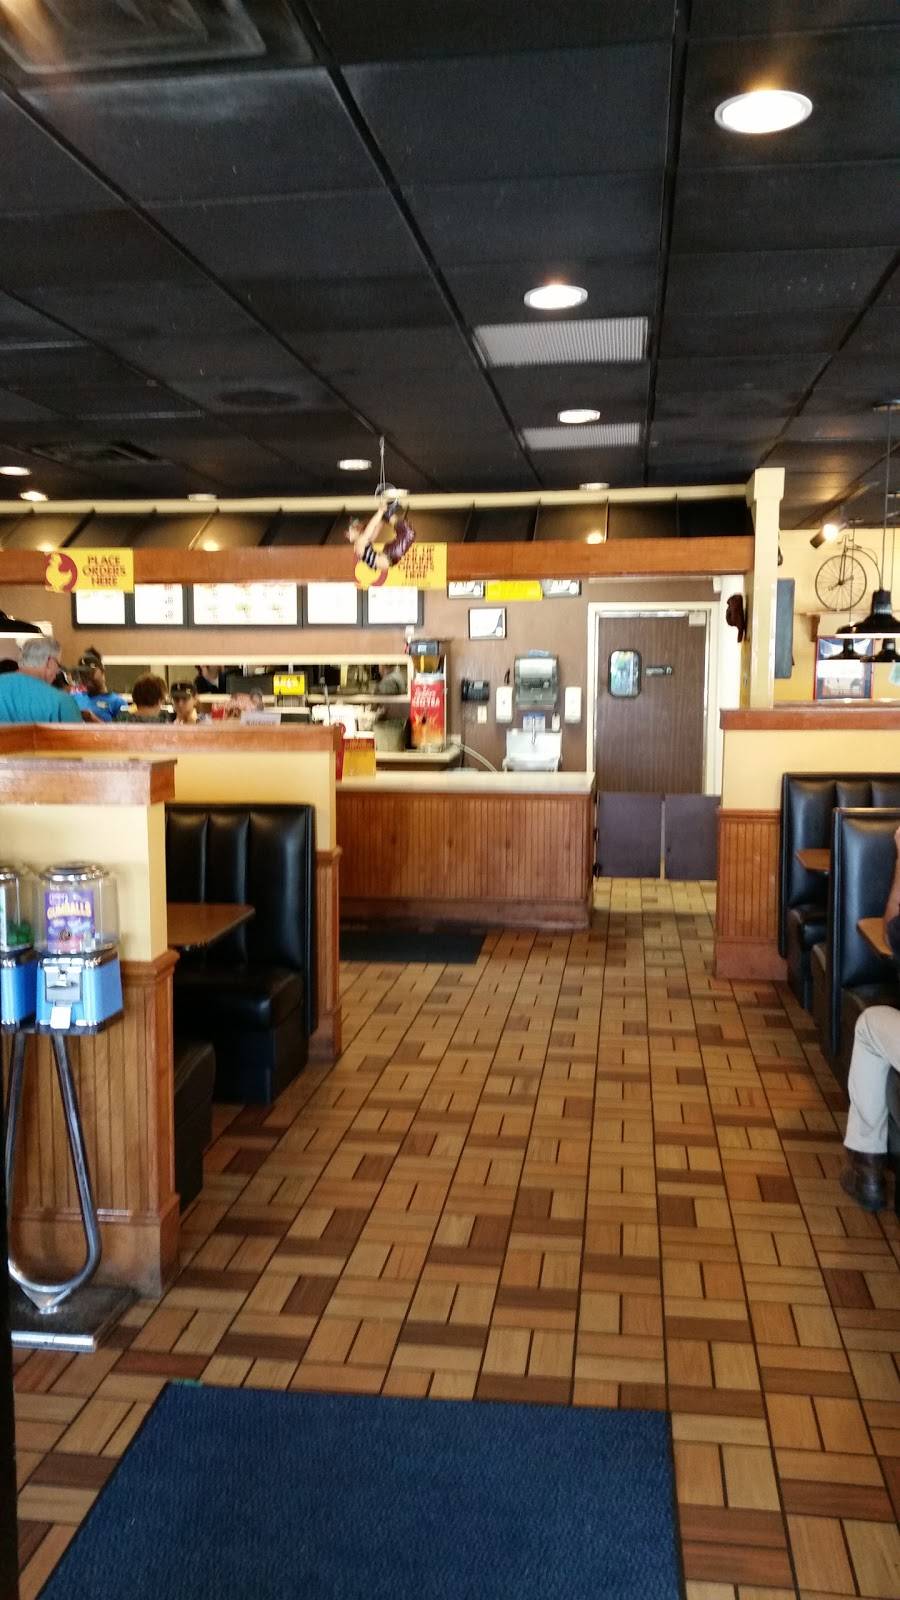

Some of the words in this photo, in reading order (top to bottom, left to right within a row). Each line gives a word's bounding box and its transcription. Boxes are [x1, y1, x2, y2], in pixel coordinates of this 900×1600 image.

[87, 555, 121, 565] PLACE
[82, 565, 127, 576] ORDERS
[91, 577, 118, 586] HERE
[46, 900, 92, 921] GUMBALLS
